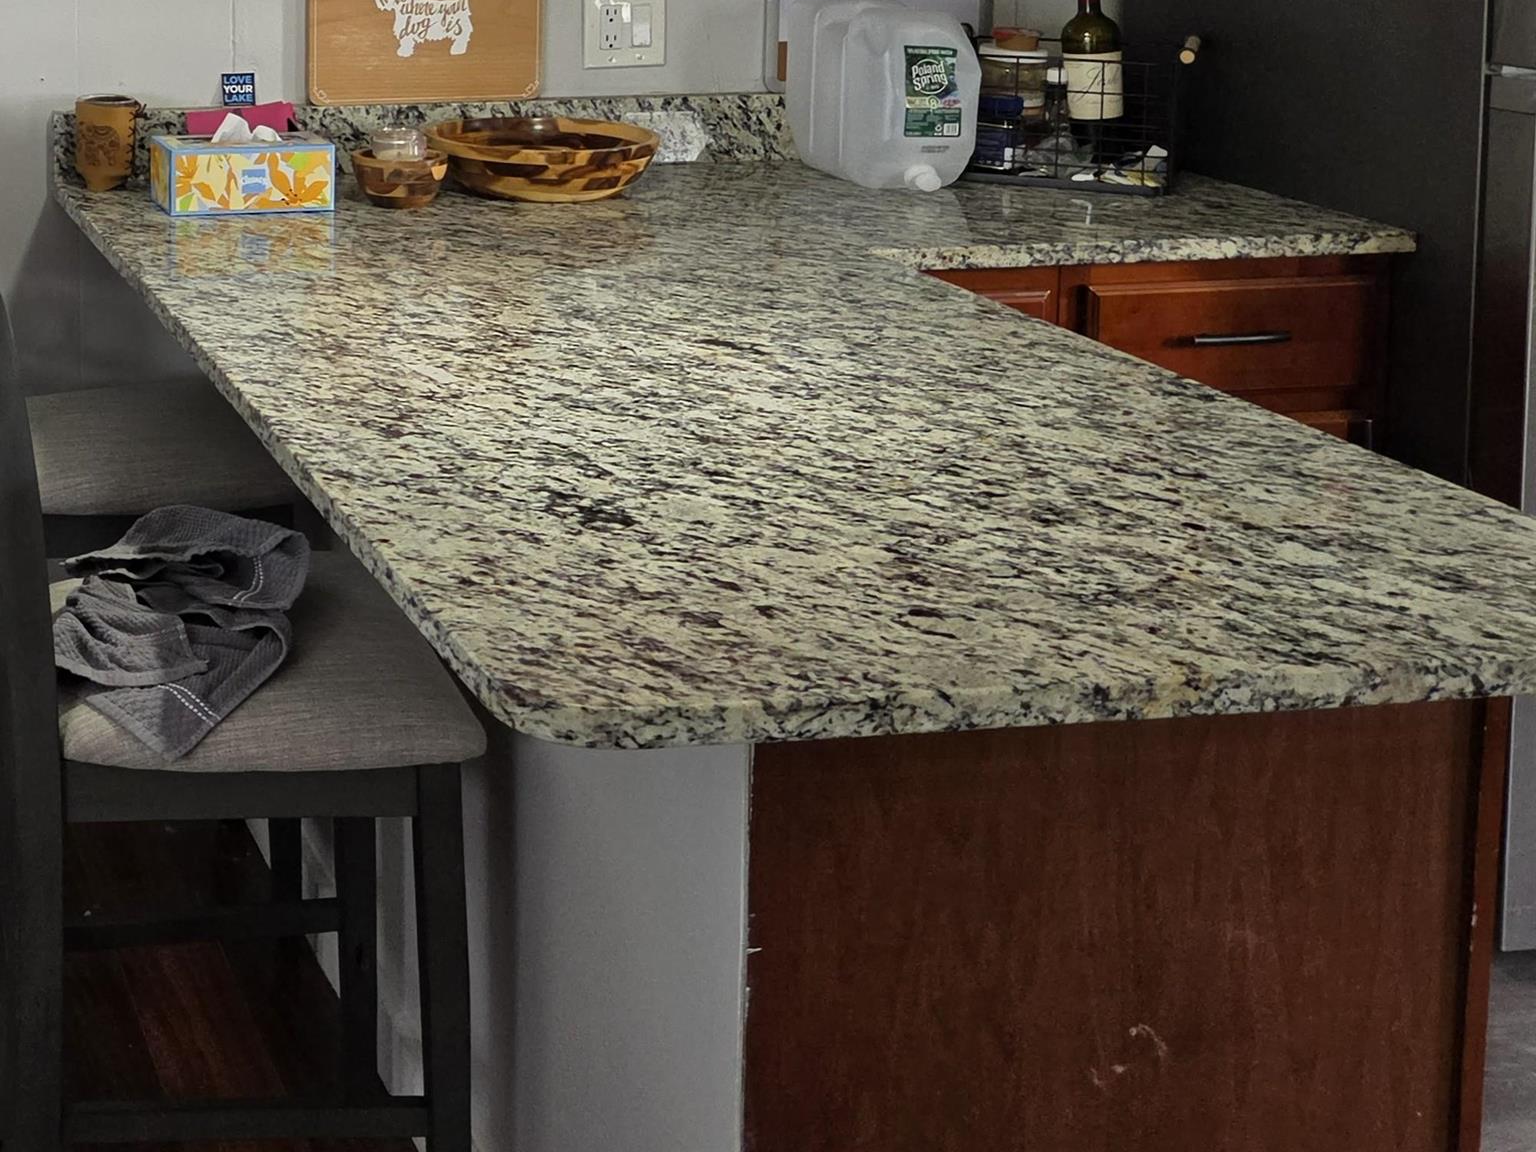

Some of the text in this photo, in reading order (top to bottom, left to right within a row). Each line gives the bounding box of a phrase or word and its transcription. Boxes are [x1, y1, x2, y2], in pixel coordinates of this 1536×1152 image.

[399, 16, 463, 39] dog is
[912, 61, 945, 78] Poland
[223, 76, 253, 84] LOVE
[913, 73, 949, 91] Spring
[223, 85, 253, 93] YOUR
[224, 94, 254, 102] LAKE
